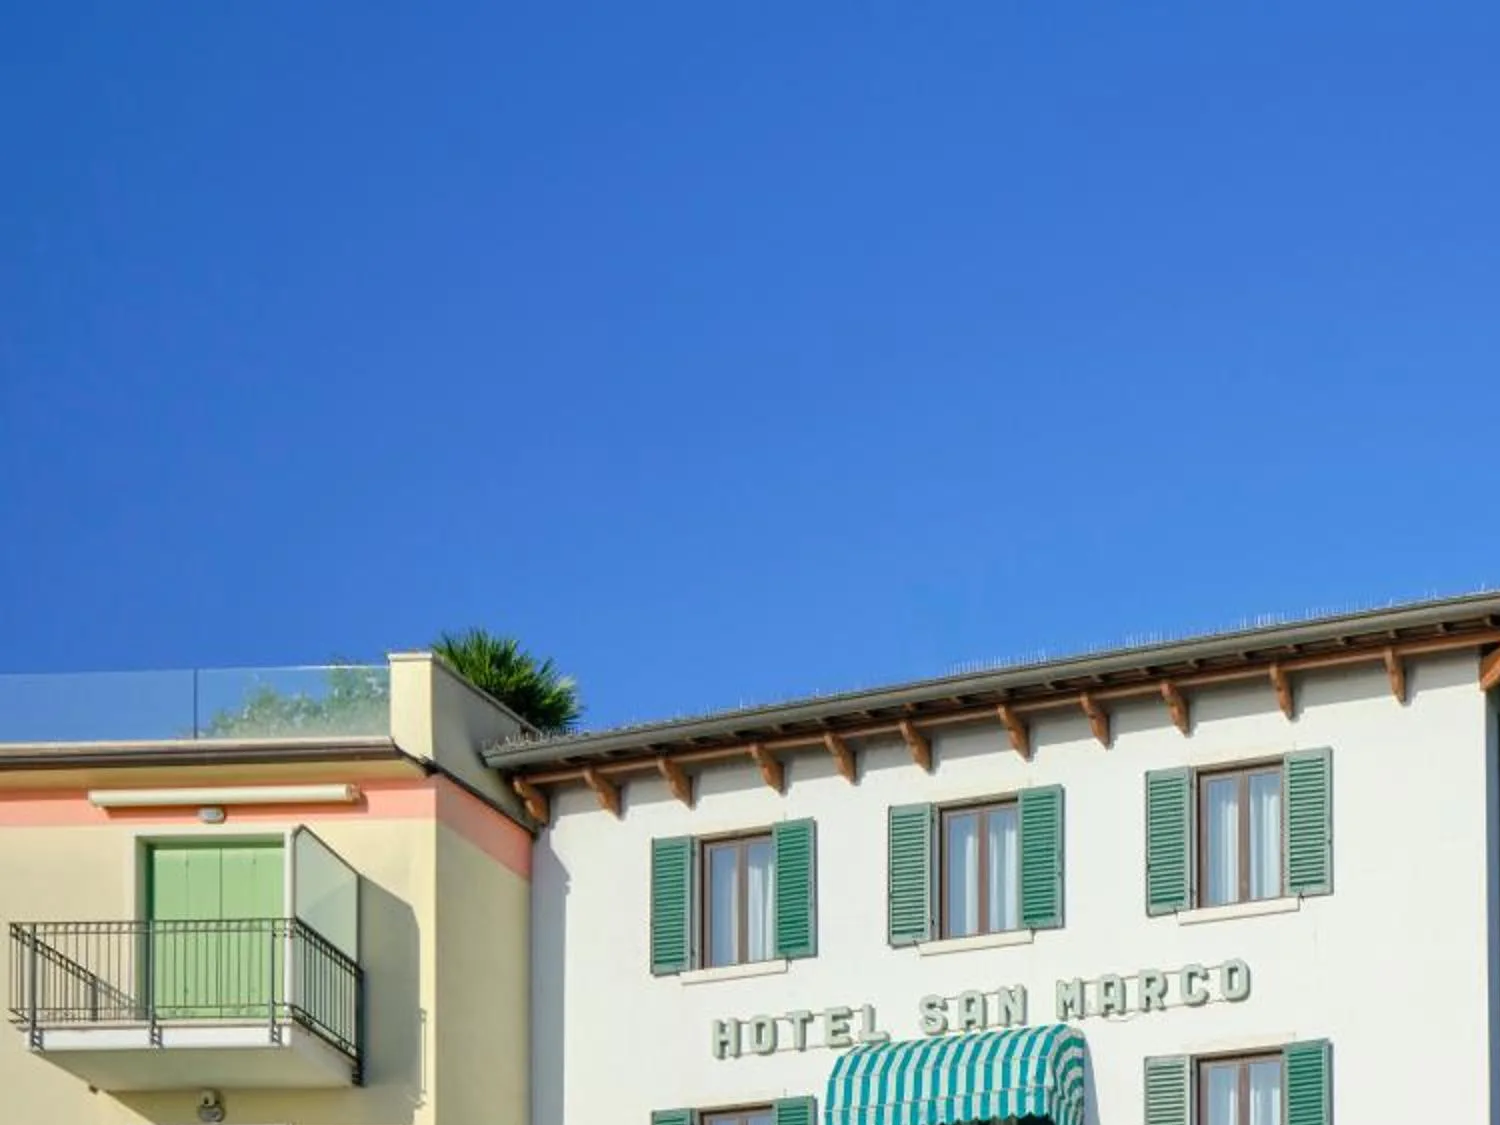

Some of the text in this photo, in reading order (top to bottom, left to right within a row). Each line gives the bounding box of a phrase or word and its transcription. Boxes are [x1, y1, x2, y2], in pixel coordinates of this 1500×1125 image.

[712, 957, 1251, 1059] HOTEL SAN MARCO
